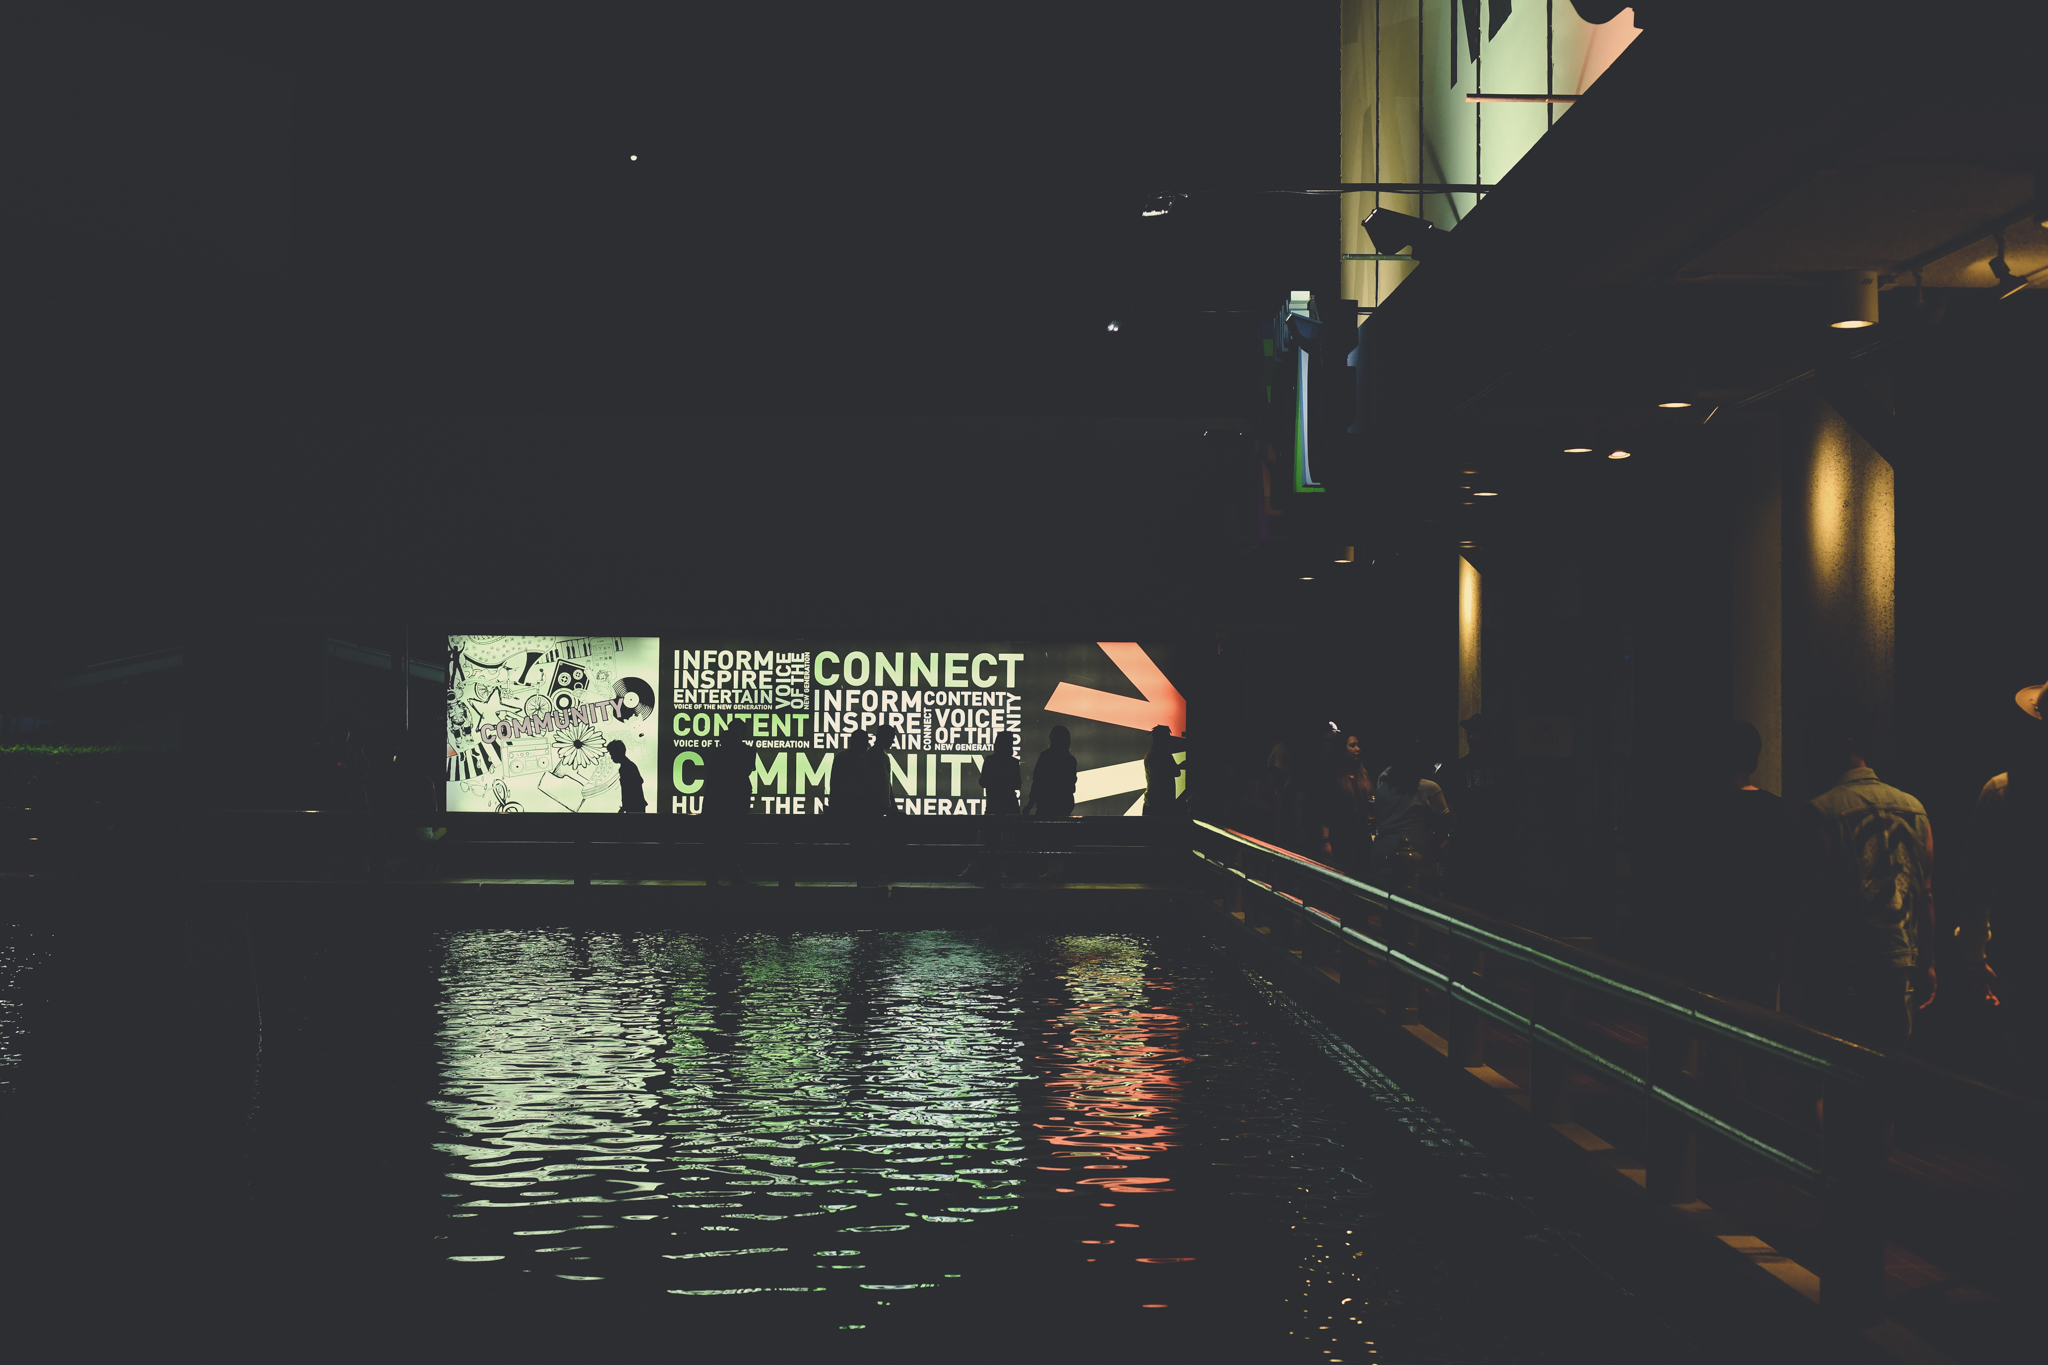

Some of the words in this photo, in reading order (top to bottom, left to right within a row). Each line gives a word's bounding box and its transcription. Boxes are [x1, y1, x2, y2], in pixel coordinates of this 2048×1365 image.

[674, 650, 773, 670] INFORM
[791, 653, 804, 685] THE
[814, 651, 1024, 688] CONNECT
[674, 670, 773, 689] INSPIRE
[775, 653, 791, 709] VOICE
[674, 689, 772, 703] ENTERTAIN
[791, 688, 804, 709] OF
[814, 690, 921, 712] INFORM
[924, 691, 1006, 706] CONTENT
[480, 697, 624, 744] COMMUNITY
[814, 712, 921, 733] INSPIRE
[935, 708, 1005, 728] VOICE
[923, 707, 932, 751] CONNECT
[935, 728, 961, 744] OF
[756, 740, 809, 748] GENERATION
[673, 750, 987, 798] CMMNIT
[672, 796, 704, 814] HU
[761, 797, 805, 814] THE
